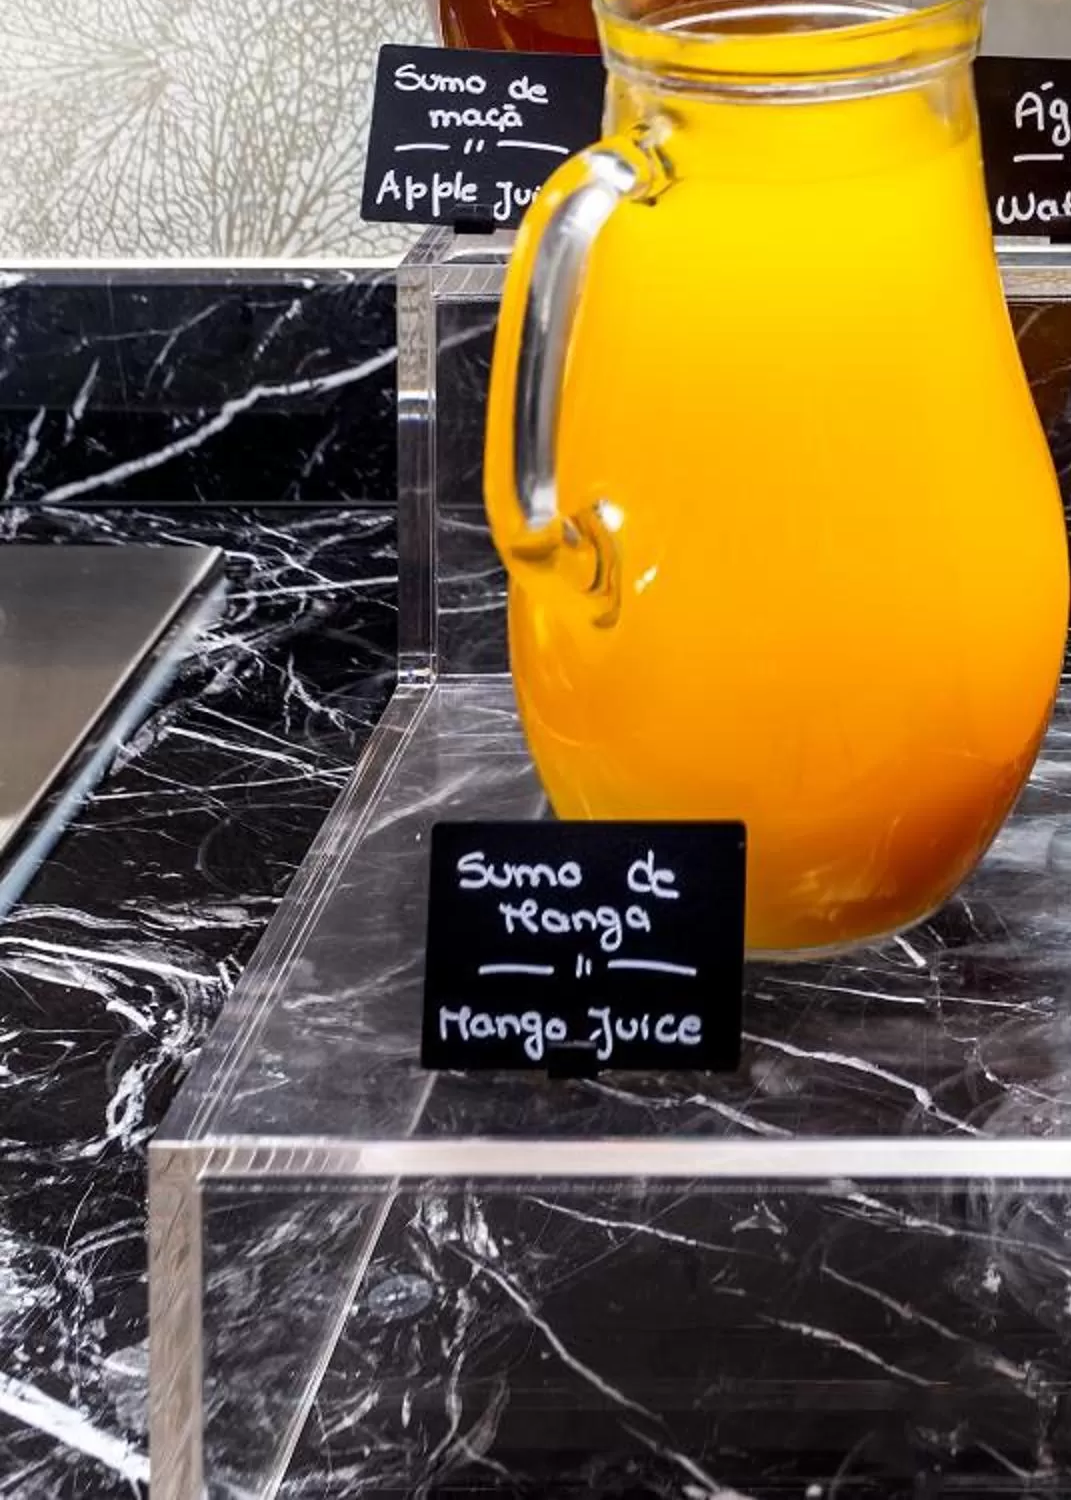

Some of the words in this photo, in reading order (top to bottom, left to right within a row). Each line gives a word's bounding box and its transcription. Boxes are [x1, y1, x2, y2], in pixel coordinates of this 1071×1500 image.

[394, 63, 487, 95] Sumo
[508, 75, 549, 104] de
[428, 103, 524, 133] maçã
[375, 169, 479, 218] Apple
[493, 180, 542, 221] Jui
[457, 850, 583, 890] Sumo
[627, 849, 680, 899] de
[499, 898, 652, 952] Manga
[438, 1004, 568, 1062] Mango
[587, 1006, 703, 1061] Juice
